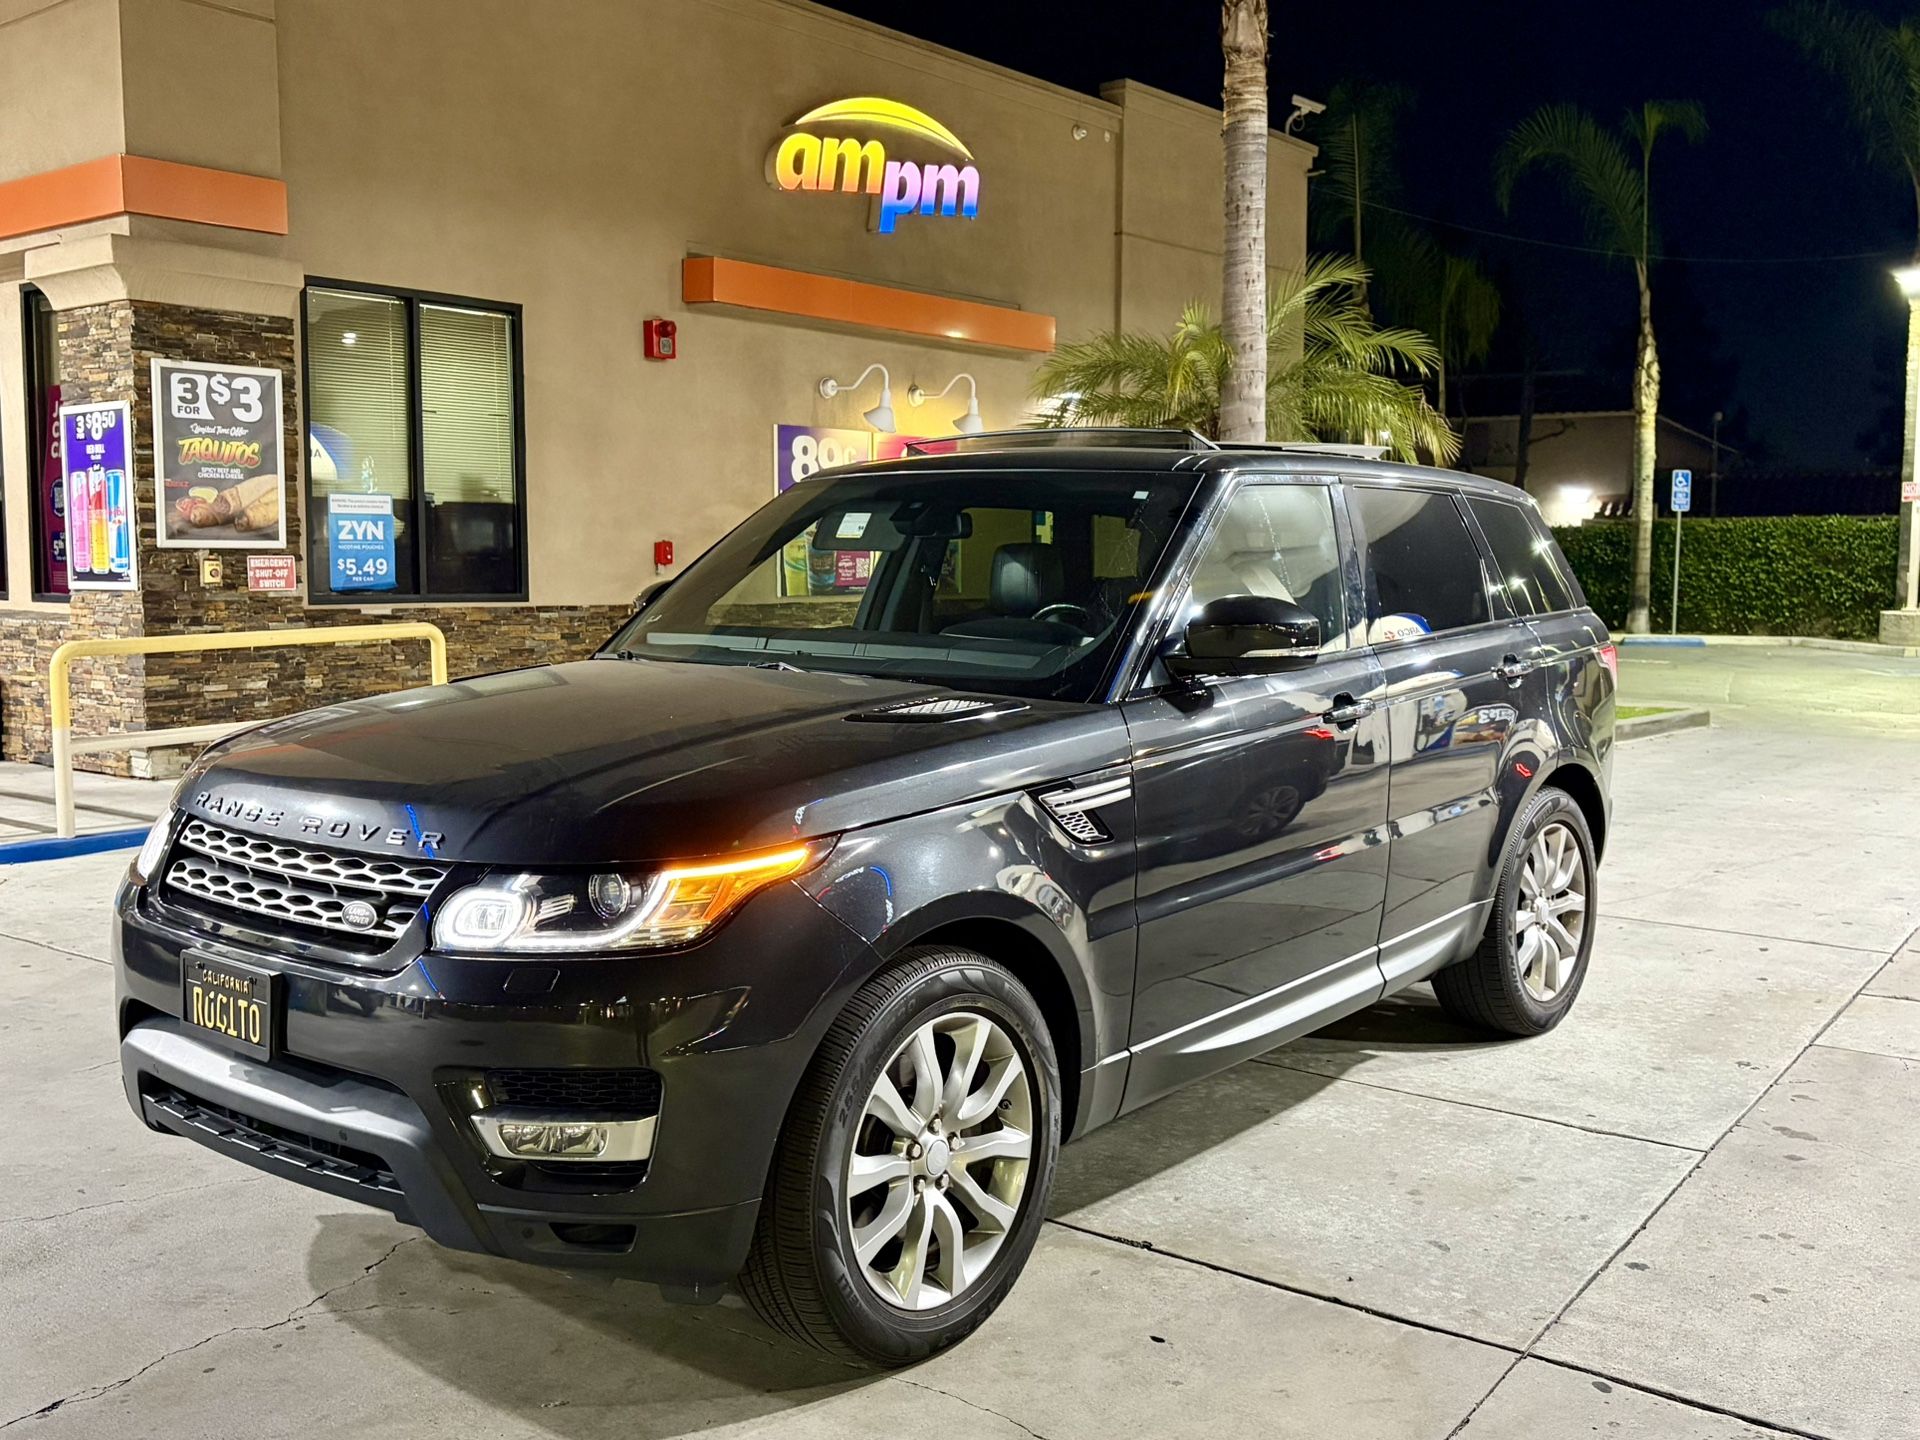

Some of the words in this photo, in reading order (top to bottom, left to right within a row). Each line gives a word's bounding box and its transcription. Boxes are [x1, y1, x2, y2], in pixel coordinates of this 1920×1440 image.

[177, 405, 200, 415] FOR
[178, 437, 261, 467] TAQUITOS
[337, 520, 384, 540] ZYN
[250, 559, 292, 568] EMERGENCY
[337, 557, 388, 576] $5.49
[255, 569, 289, 578] SHUT-OFF
[259, 579, 286, 588] SWITCH
[195, 791, 285, 827] RANGE
[299, 813, 448, 851] ROVER
[203, 969, 250, 994] CALIFORNIA
